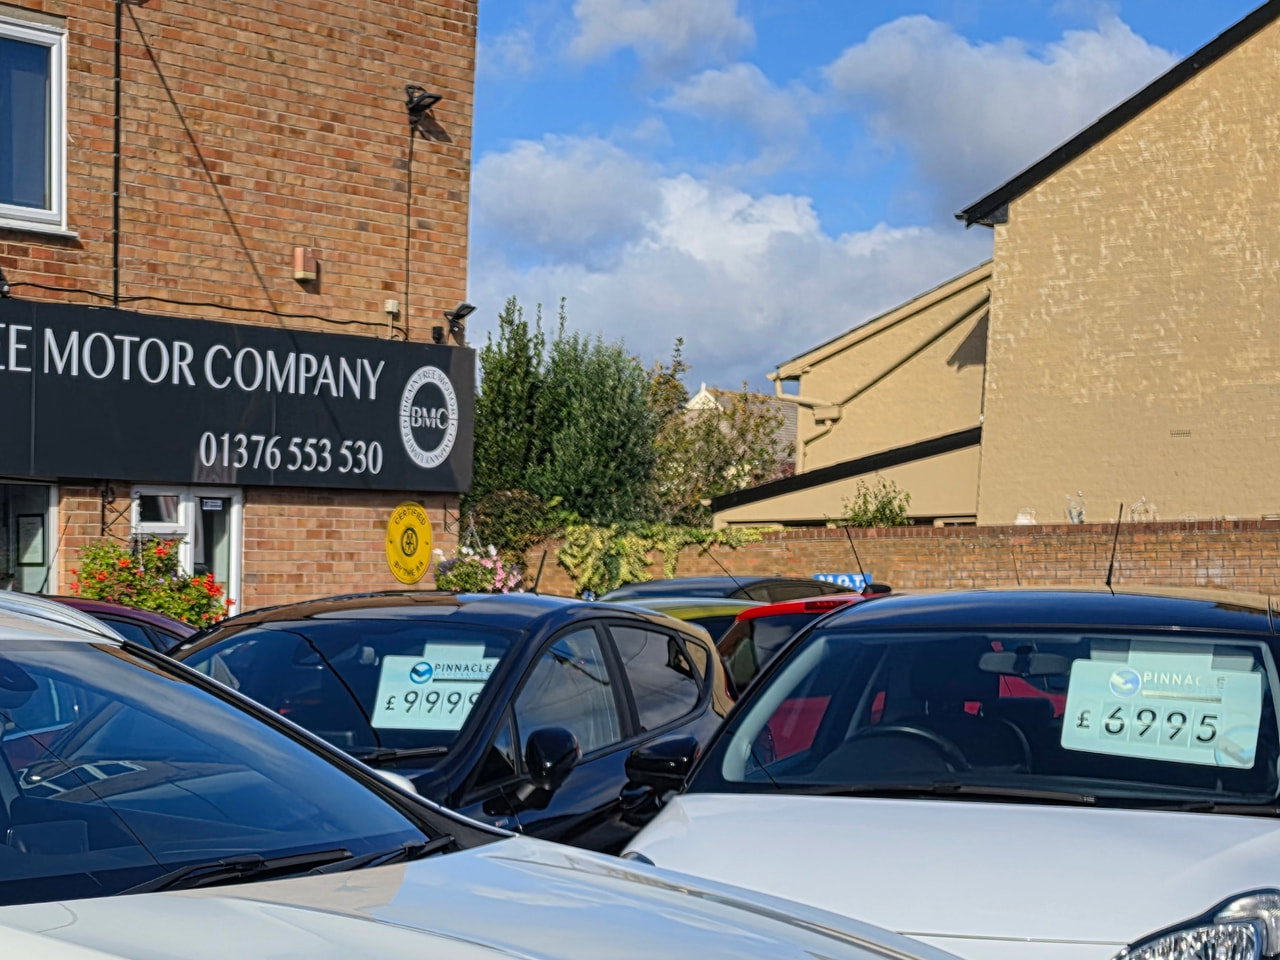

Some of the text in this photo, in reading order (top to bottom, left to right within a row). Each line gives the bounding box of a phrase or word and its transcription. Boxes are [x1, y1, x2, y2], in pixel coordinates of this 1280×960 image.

[42, 327, 197, 386] MOTOR
[204, 343, 385, 401] COMPANY
[411, 406, 450, 430] BMC
[199, 430, 384, 475] 01376 553 530
[434, 663, 493, 673] PINNACLE
